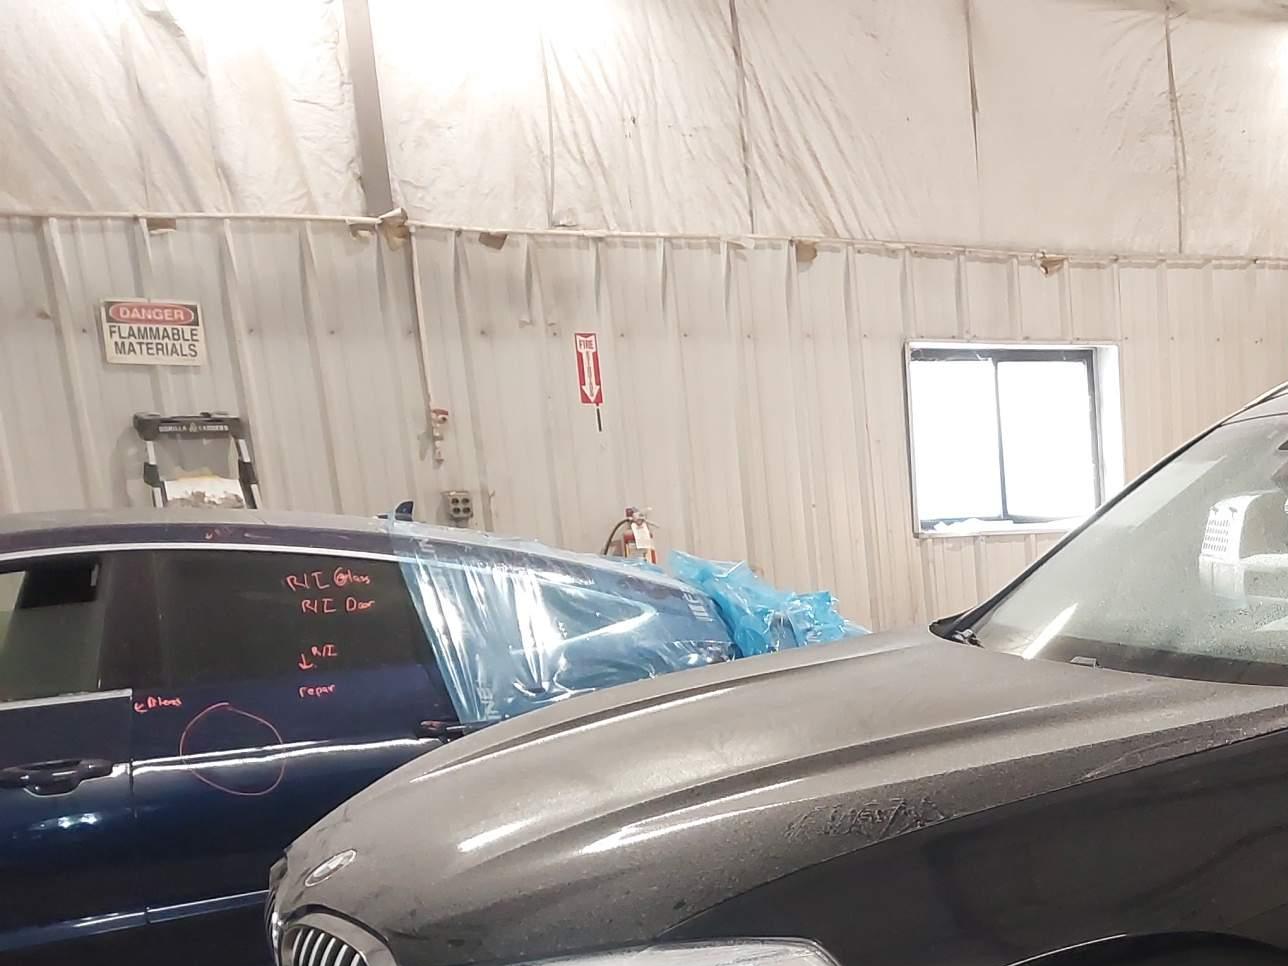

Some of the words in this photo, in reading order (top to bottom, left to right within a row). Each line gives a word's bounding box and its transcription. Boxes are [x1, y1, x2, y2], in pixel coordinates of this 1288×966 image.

[119, 306, 184, 321] DANGER
[108, 325, 199, 342] FLAMMABLE
[114, 341, 198, 358] MATERIALS
[579, 340, 594, 349] FIRE
[346, 596, 375, 612] Door
